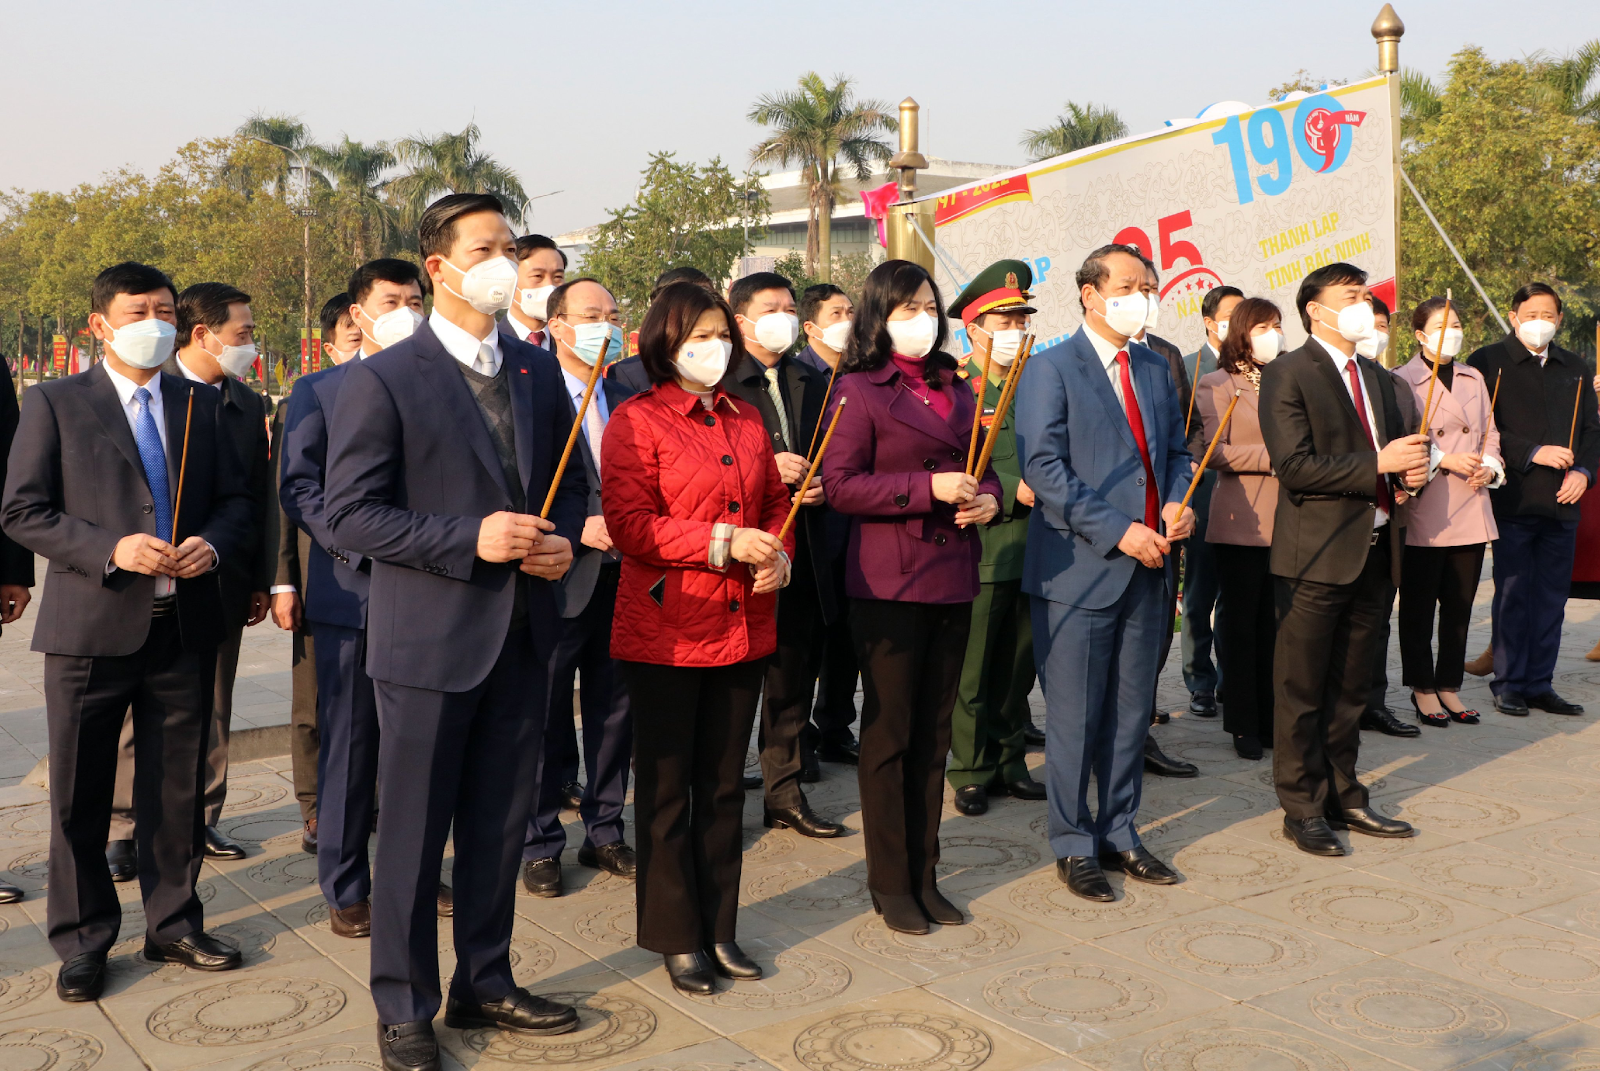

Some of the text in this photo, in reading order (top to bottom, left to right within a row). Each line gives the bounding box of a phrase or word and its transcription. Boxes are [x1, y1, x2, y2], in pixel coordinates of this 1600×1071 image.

[1211, 93, 1353, 205] 190
[1258, 211, 1339, 259] THÀNH LẬP
[1265, 231, 1372, 291] TỈNH BẮC NINH
